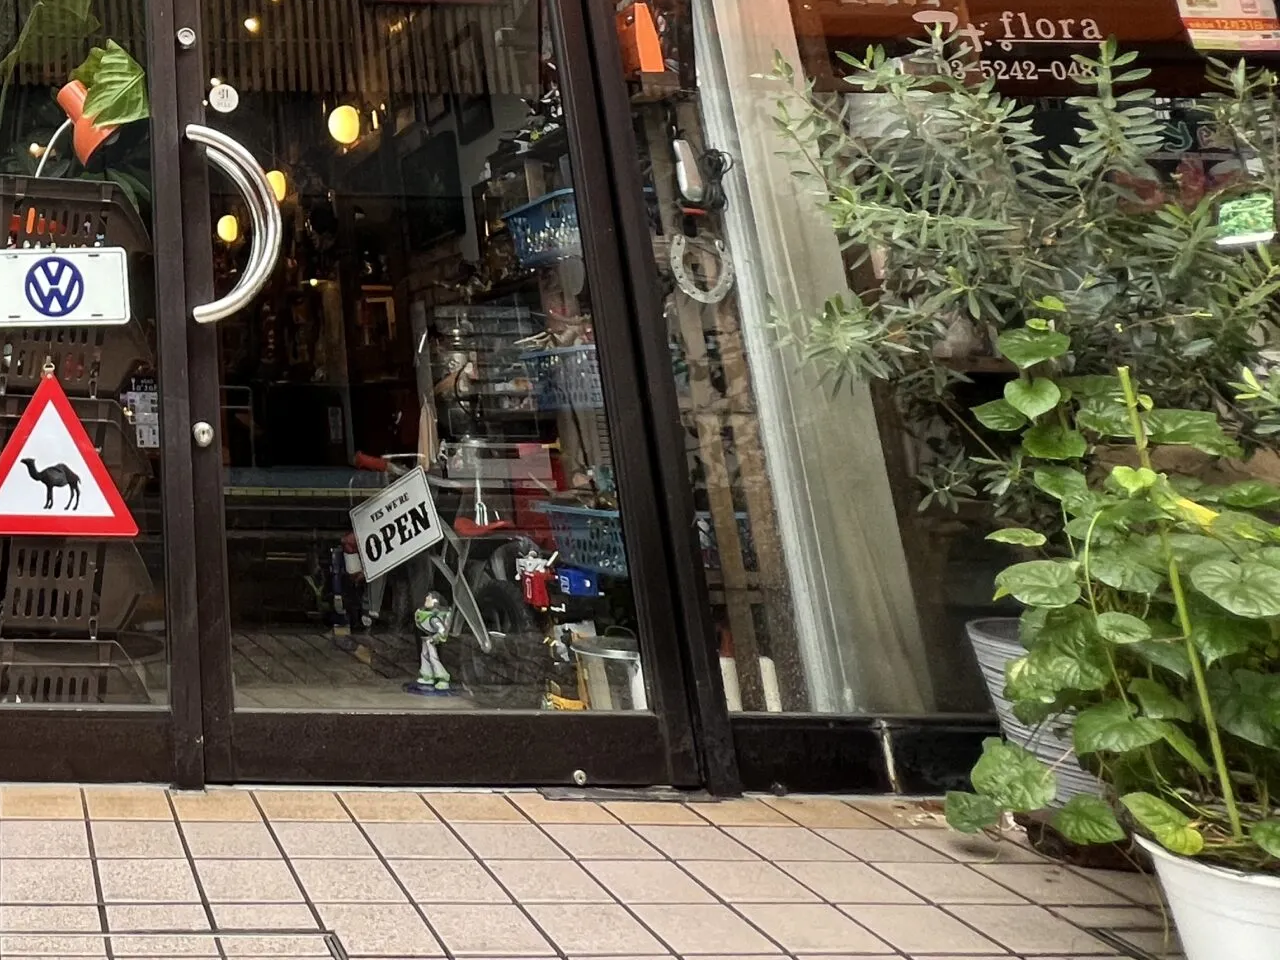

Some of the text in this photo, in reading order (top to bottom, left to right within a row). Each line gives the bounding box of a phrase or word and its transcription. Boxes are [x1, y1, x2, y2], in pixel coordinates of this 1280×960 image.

[999, 10, 1103, 39] flora
[369, 492, 410, 523] YES WE'RE
[365, 501, 431, 562] OPEN
